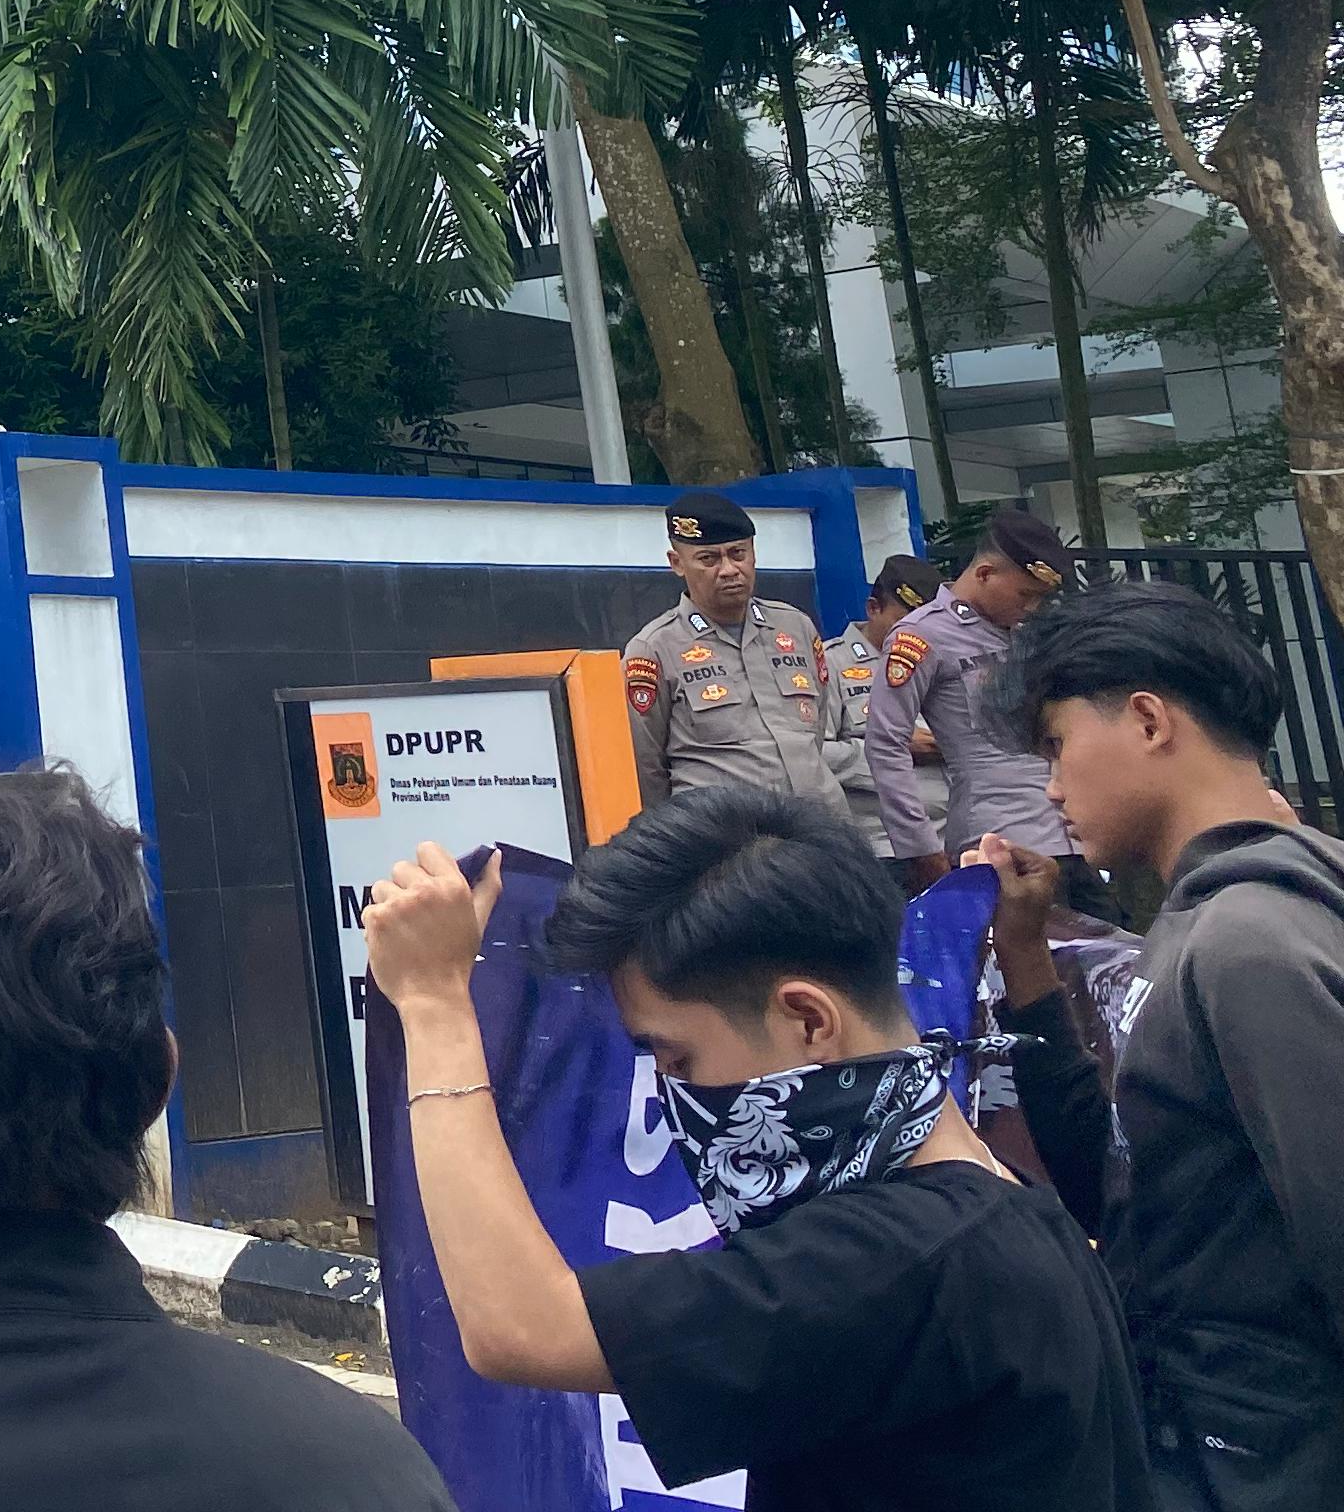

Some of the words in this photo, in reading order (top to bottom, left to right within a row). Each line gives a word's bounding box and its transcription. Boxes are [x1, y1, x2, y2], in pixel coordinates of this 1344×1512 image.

[771, 656, 808, 669] POLRI
[386, 729, 485, 756] DPUPR
[390, 778, 411, 788] Dinas
[413, 776, 450, 790] Pekerjaan
[452, 776, 476, 787] Umum
[478, 775, 492, 786] dan
[494, 775, 530, 786] Penataan
[532, 774, 557, 788] Ruang
[392, 792, 421, 802] Provinsi
[424, 792, 450, 802] Banten
